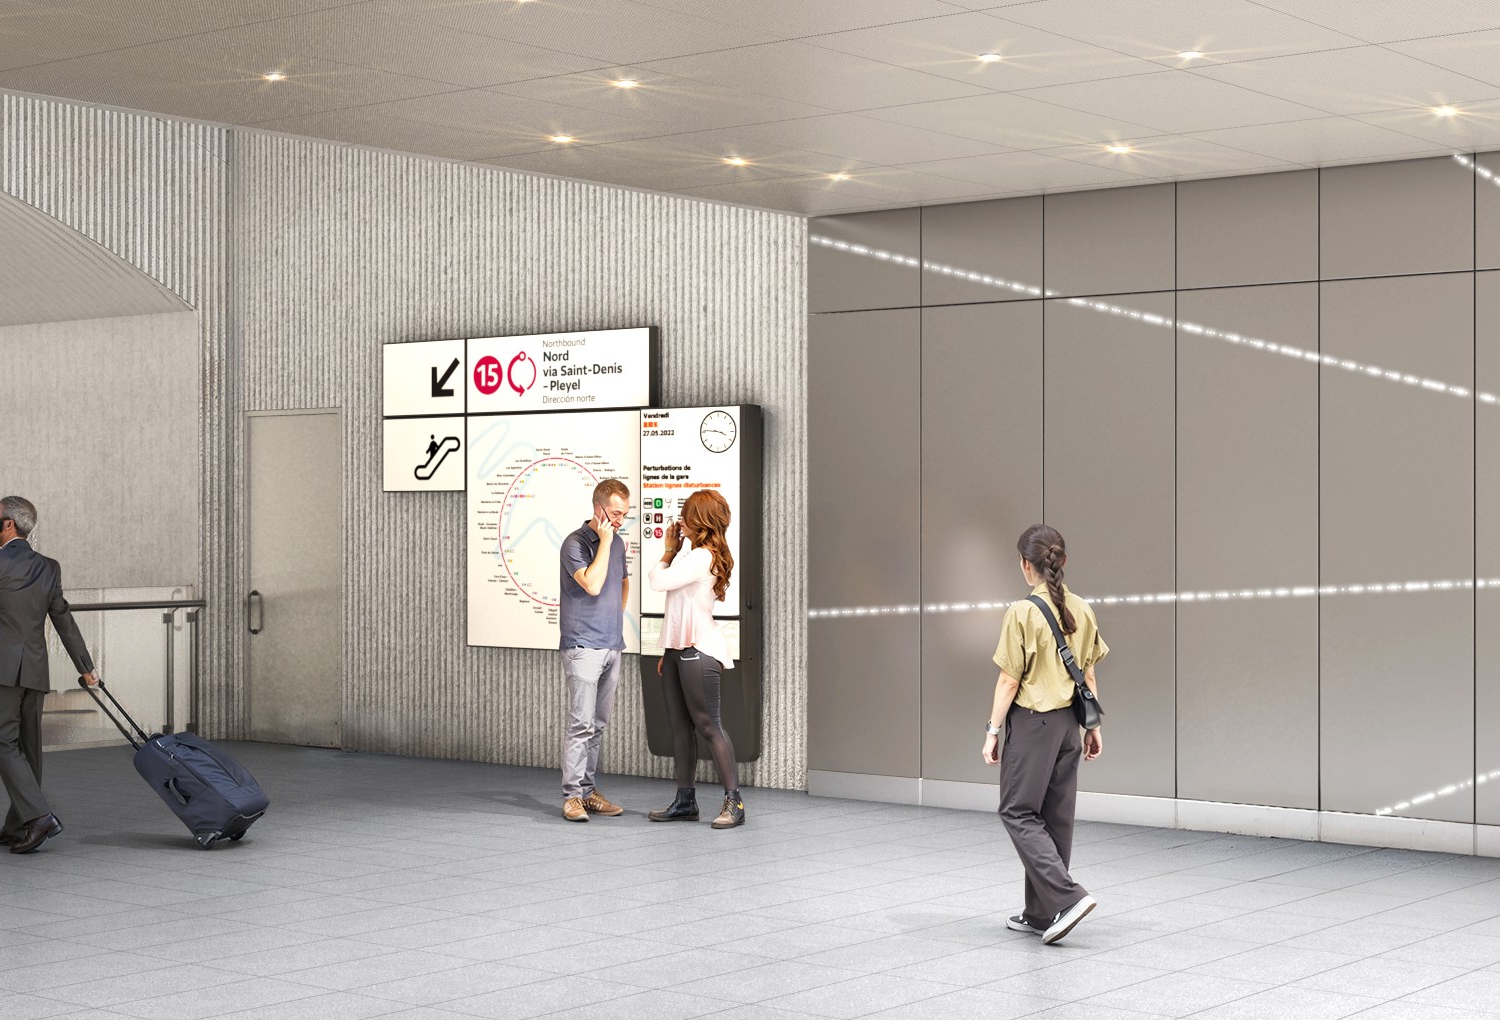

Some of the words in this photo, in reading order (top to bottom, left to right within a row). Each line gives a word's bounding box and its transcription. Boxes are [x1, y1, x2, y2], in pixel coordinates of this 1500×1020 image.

[542, 338, 586, 348] Northbound
[543, 350, 569, 362] Nord
[476, 363, 499, 387] 15
[543, 366, 558, 377] via
[560, 362, 623, 376] Saint-Denis
[550, 379, 581, 393] Pleyel
[542, 395, 575, 404] Dirección
[576, 394, 596, 403] norte
